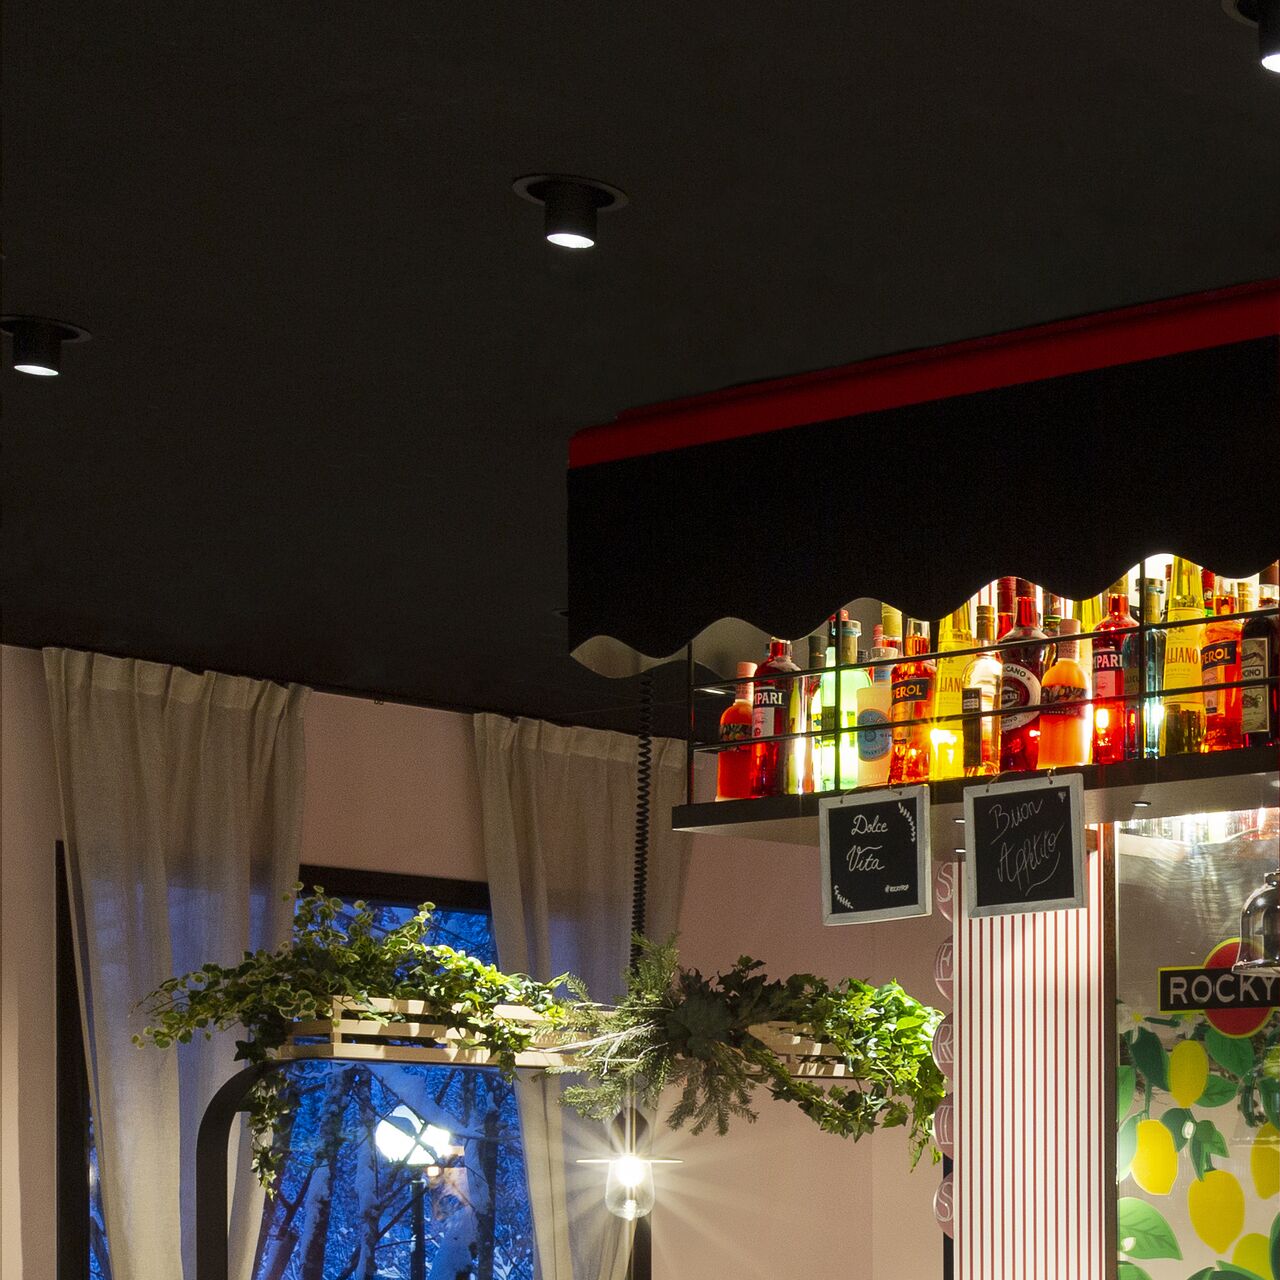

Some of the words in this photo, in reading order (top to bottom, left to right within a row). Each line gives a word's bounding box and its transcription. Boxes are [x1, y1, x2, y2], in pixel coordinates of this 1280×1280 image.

[1096, 654, 1123, 667] PARI
[1166, 648, 1199, 664] LLIANO
[756, 692, 783, 705] PARI
[851, 814, 888, 836] Dolce
[846, 845, 885, 872] Vita
